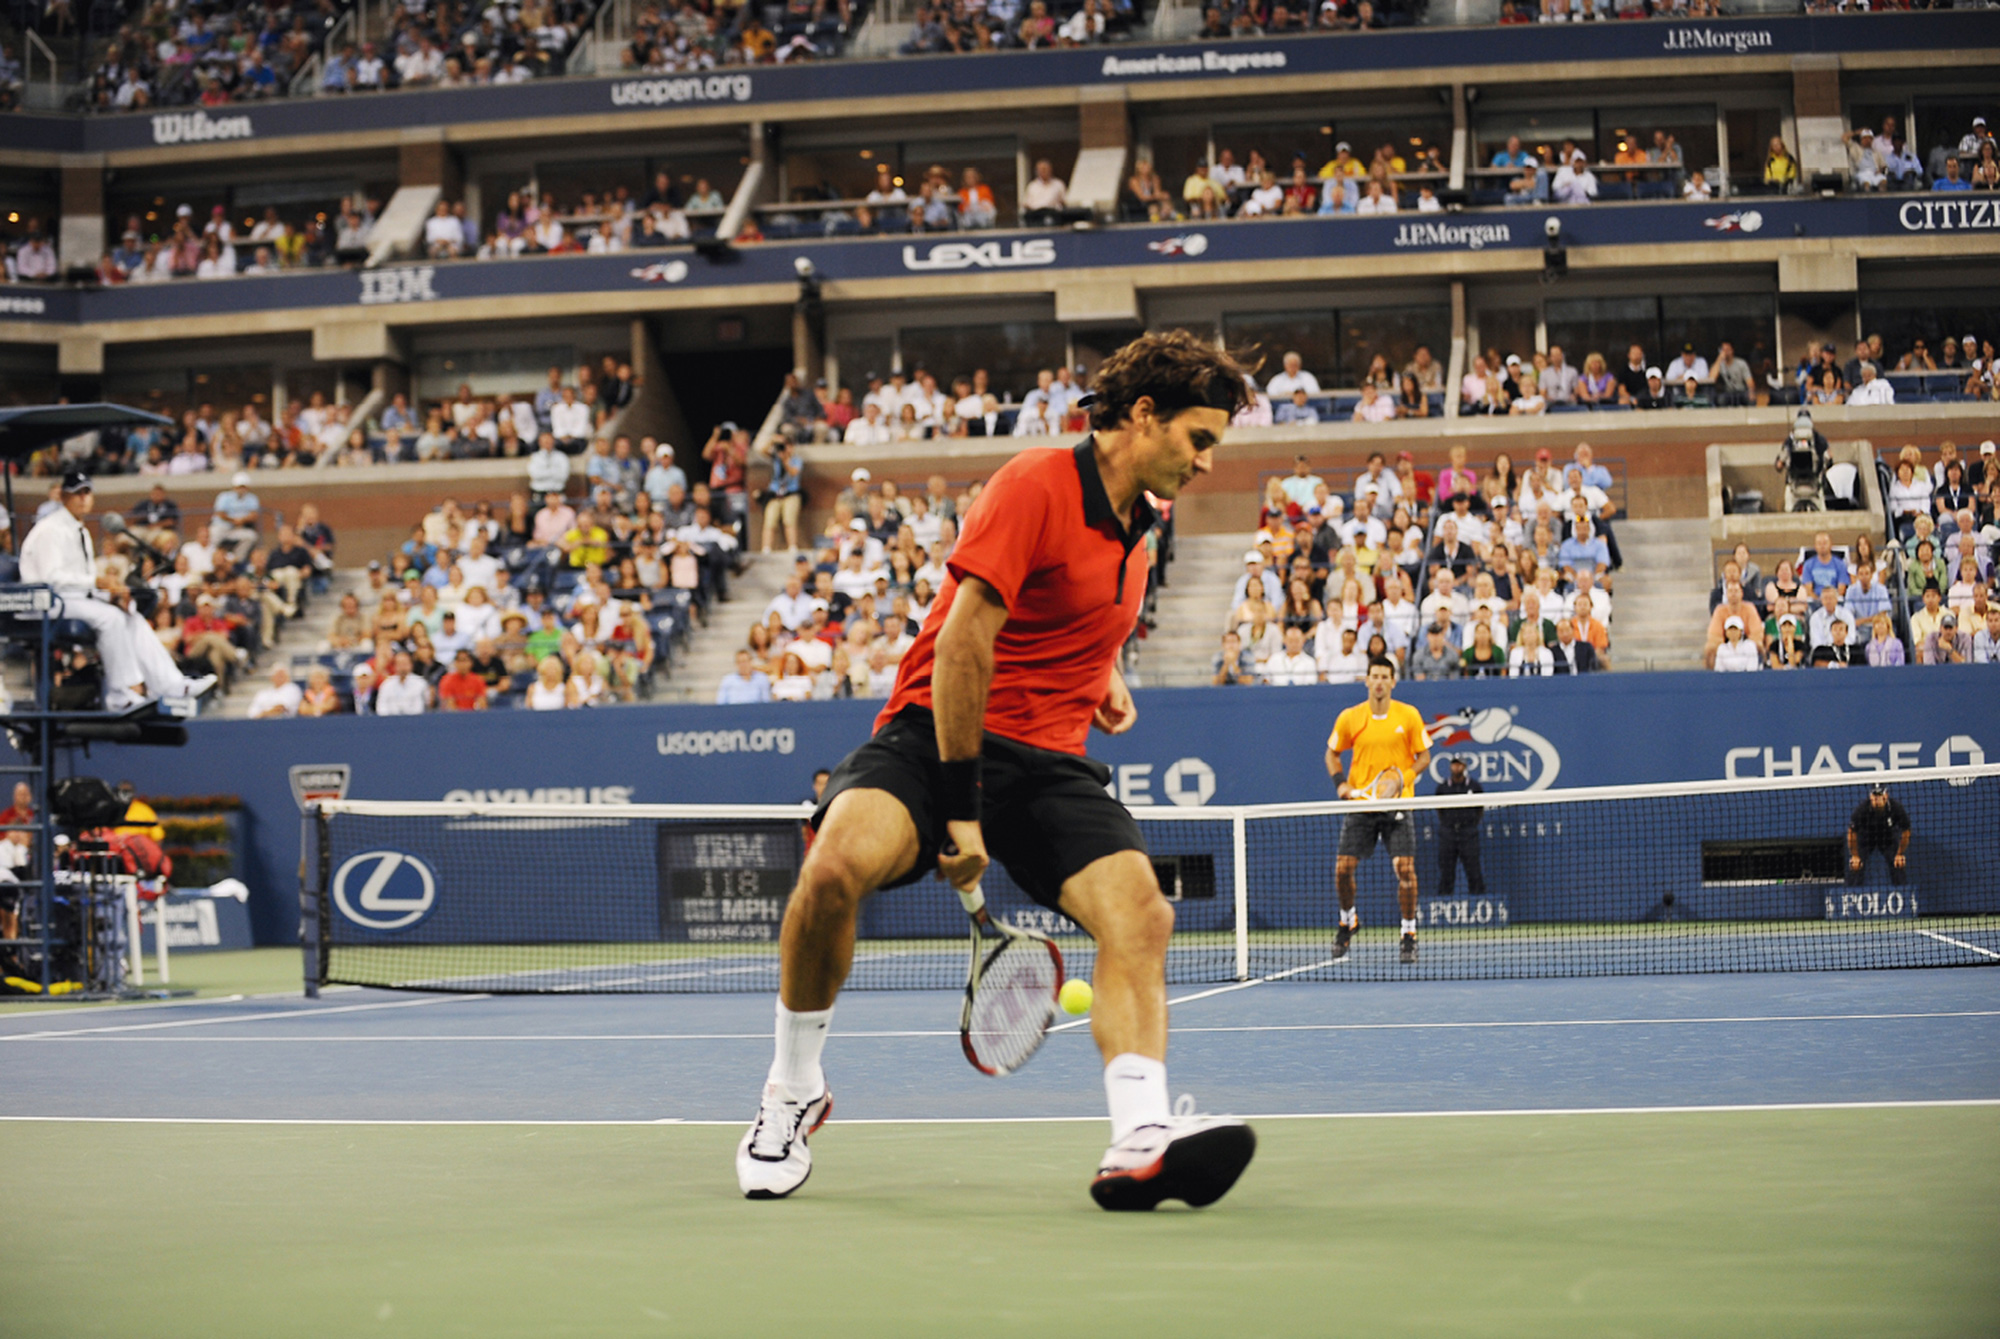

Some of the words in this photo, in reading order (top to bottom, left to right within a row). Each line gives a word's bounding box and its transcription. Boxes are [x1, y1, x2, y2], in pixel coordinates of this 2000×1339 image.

[1102, 53, 1202, 76] American
[1203, 51, 1287, 73] Express
[611, 74, 752, 106] usopen.org
[152, 111, 253, 144] Wilson
[902, 239, 1057, 271] LEXUS
[359, 266, 439, 305] IBM
[656, 727, 796, 757] usopen.org
[693, 832, 767, 868] IBM
[722, 898, 779, 921] MPH
[1429, 899, 1493, 924] POLO
[1841, 892, 1903, 916] POLO
